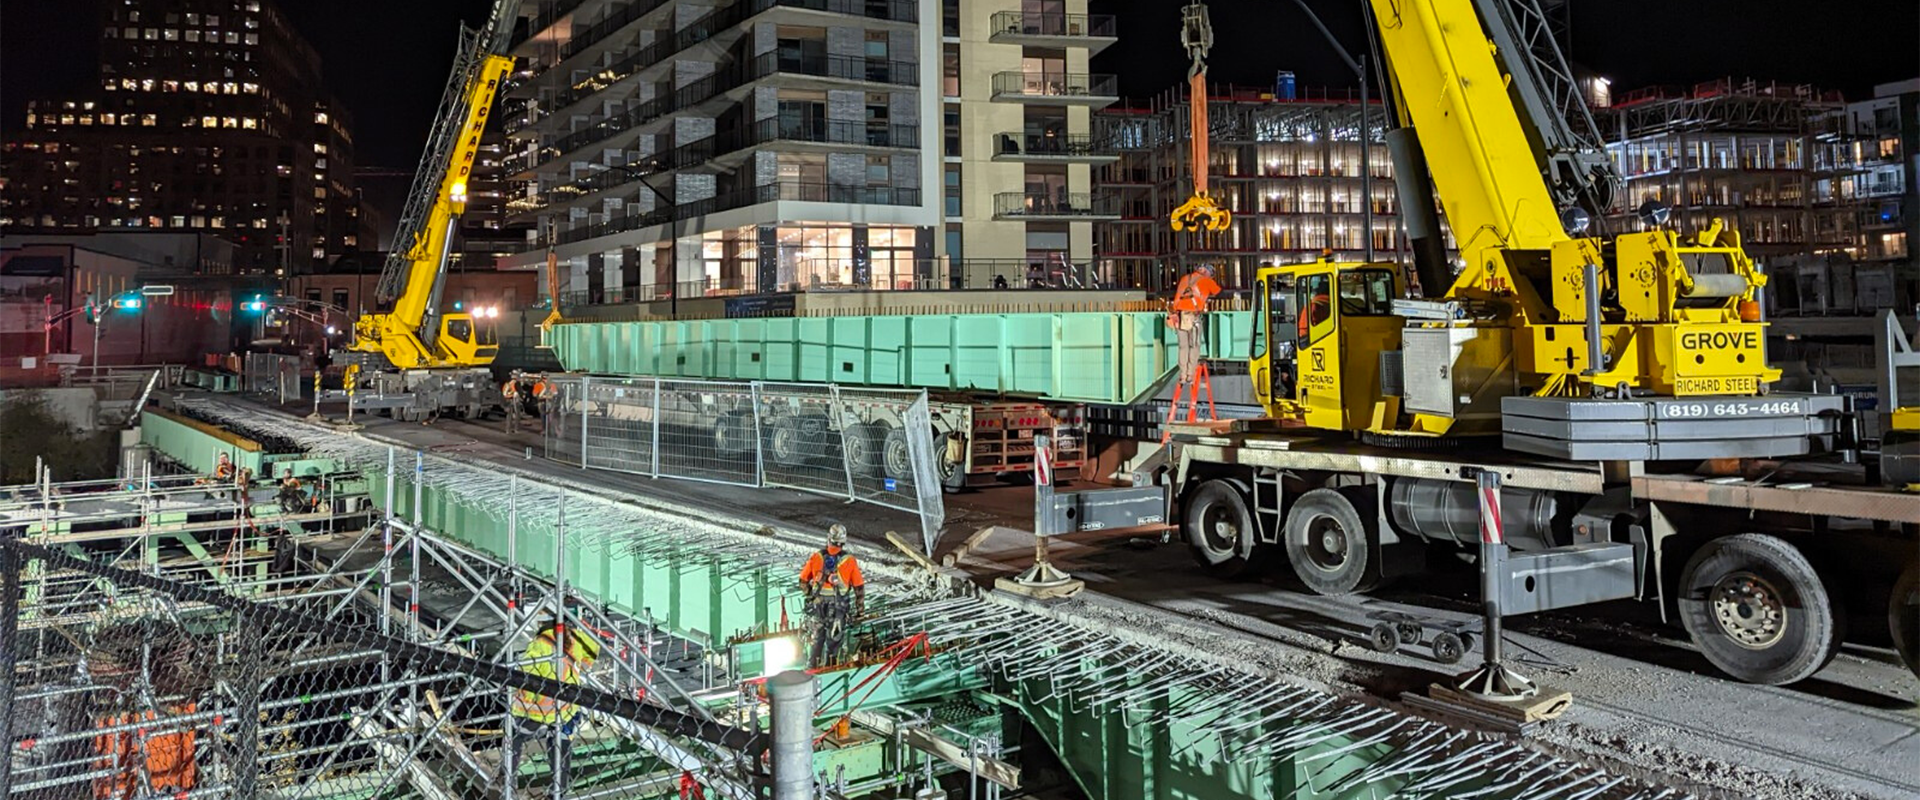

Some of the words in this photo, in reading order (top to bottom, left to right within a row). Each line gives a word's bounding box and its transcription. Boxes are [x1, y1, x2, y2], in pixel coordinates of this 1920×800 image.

[460, 79, 496, 178] RICHARD
[1681, 331, 1757, 350] GROVE
[1303, 374, 1334, 385] RICHARD
[1677, 378, 1721, 393] RICHARD
[1725, 377, 1757, 392] STEEL
[1662, 403, 1709, 418] (819)
[1713, 402, 1801, 416] 643-4464
